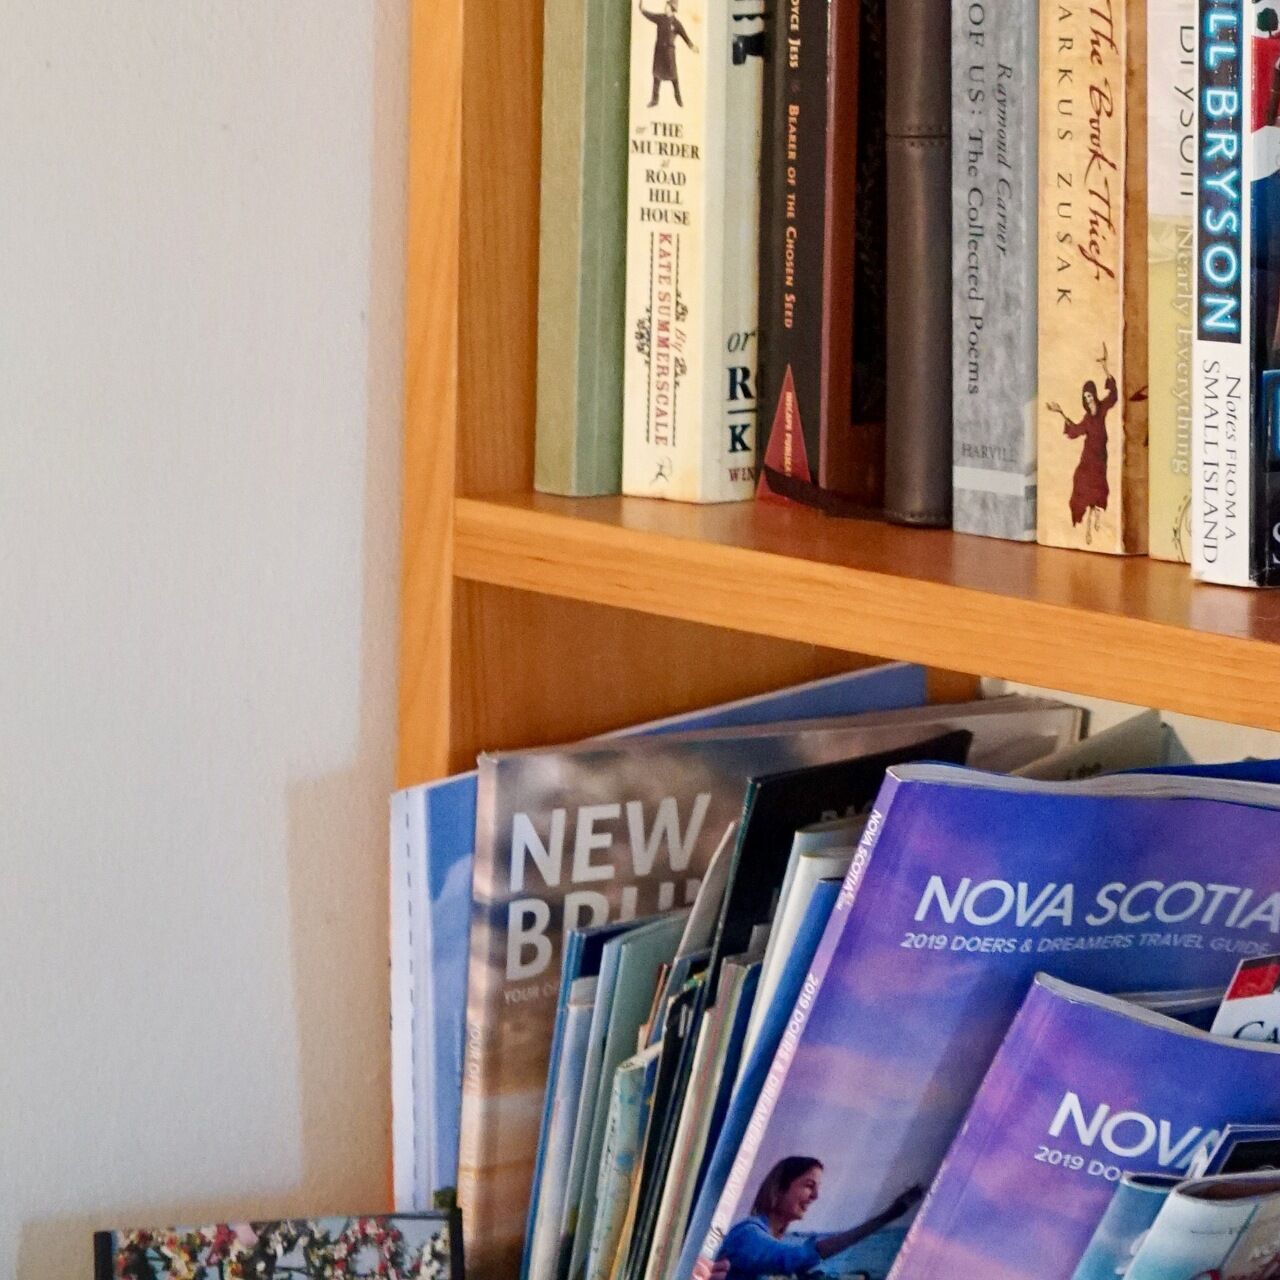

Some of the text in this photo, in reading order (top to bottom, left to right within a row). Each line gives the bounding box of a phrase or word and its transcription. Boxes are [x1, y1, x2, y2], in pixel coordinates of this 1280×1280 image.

[966, 2, 985, 48] OF
[966, 64, 985, 114] US:
[631, 139, 701, 160] MURDER
[650, 122, 684, 138] THE
[966, 128, 985, 177] The
[1087, 76, 1116, 173] Book
[645, 169, 687, 187] ROAD
[648, 188, 684, 205] HILL
[1202, 86, 1239, 333] BRYSON
[639, 206, 691, 226] HOUSE
[965, 187, 985, 302] Collected
[1055, 172, 1074, 307] ZUSAK
[1078, 171, 1119, 284] Thief
[654, 232, 673, 446] KATE SUMMERSCALE
[964, 314, 984, 395] Poems
[1201, 359, 1220, 564] SMALL ISLAND
[510, 793, 712, 893] NEW
[914, 875, 1075, 928] NOVA
